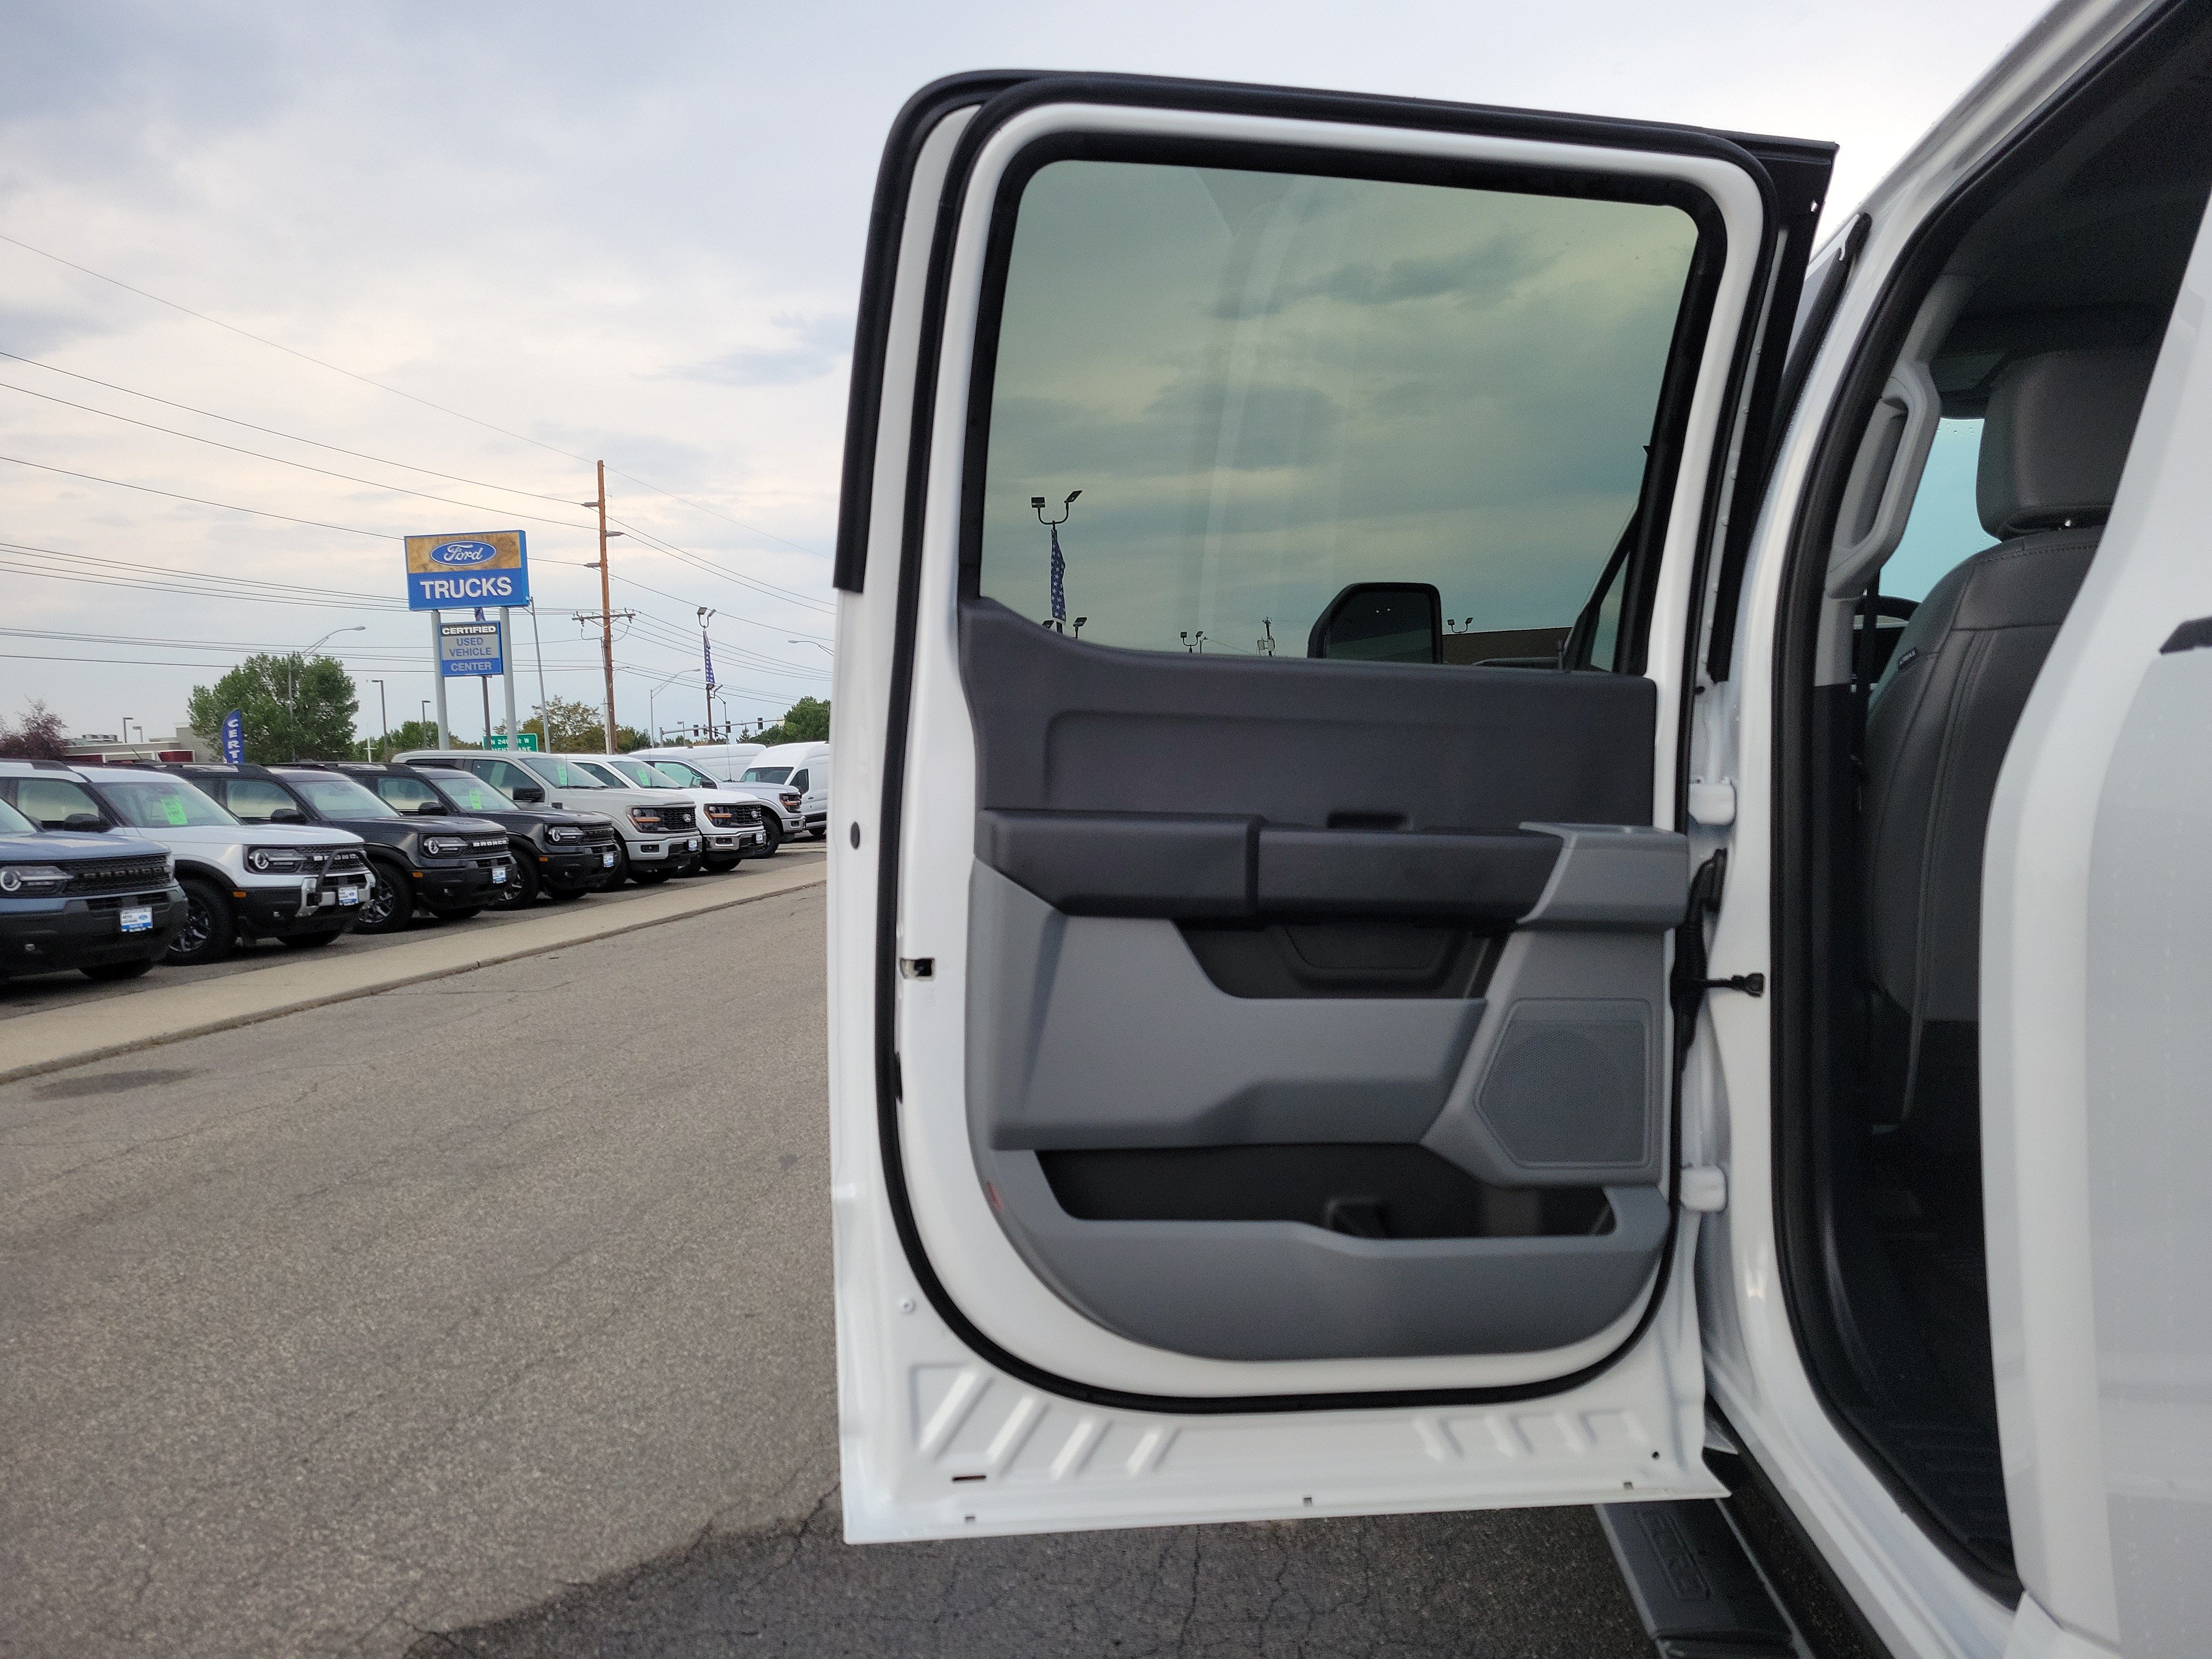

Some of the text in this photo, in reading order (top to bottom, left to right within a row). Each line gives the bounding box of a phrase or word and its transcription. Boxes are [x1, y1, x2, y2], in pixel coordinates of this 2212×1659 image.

[443, 544, 483, 561] Ford
[420, 577, 512, 599] TRUCKS
[442, 626, 496, 635] CERTIFIED
[456, 637, 484, 646] USED
[449, 647, 492, 657] VEHICLE
[450, 662, 492, 672] CENTER
[227, 719, 241, 764] CERT
